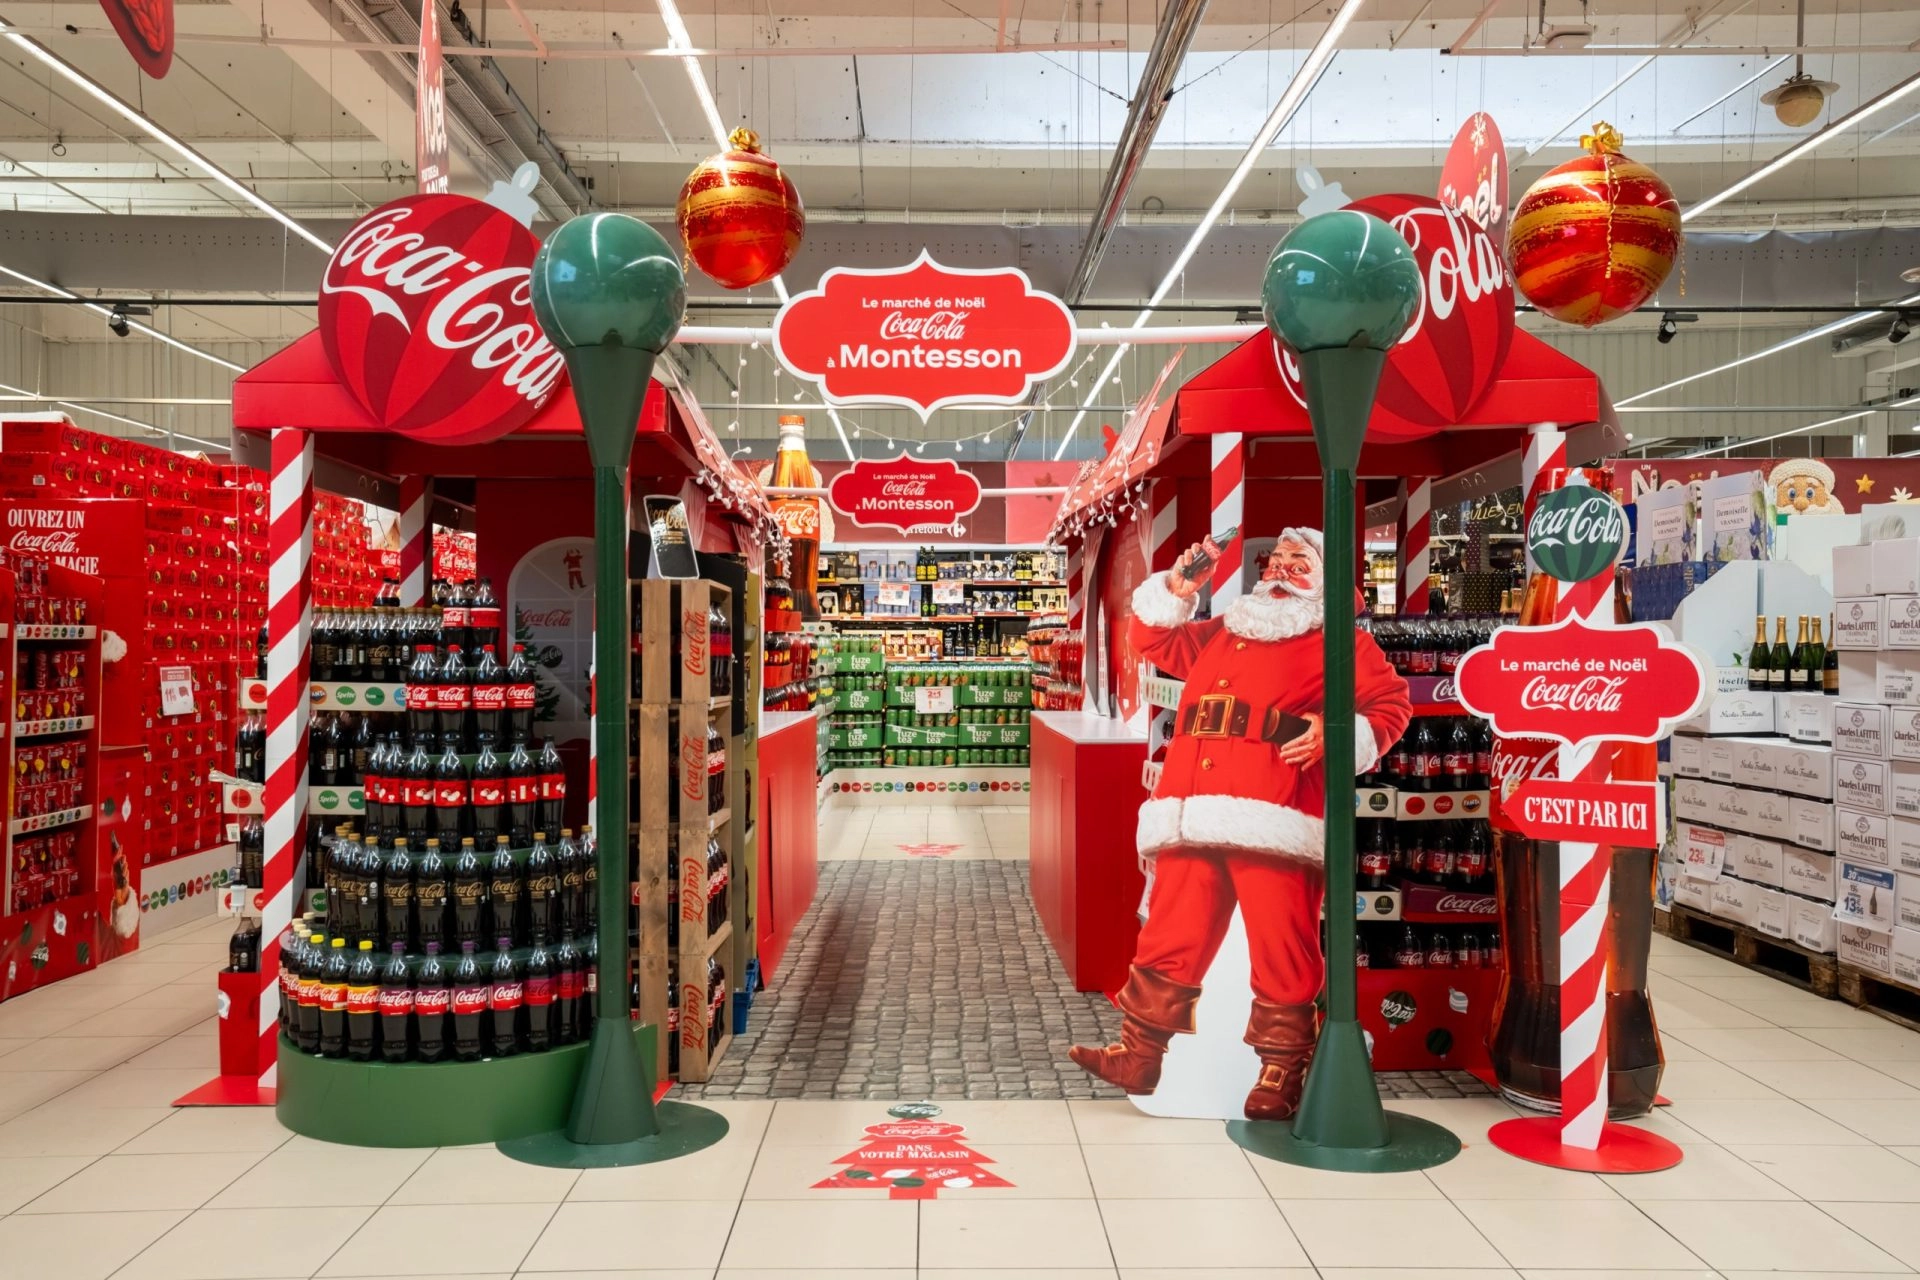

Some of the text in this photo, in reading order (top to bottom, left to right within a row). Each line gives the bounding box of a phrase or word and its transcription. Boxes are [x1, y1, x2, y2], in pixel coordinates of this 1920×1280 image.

[322, 207, 566, 402] Coca-Cola
[862, 296, 986, 309] Le marché de Noël
[880, 311, 970, 341] Coca-Cola
[826, 344, 1022, 369] à Montesson
[882, 480, 928, 496] Coca-Cola
[862, 497, 955, 510] Montesson
[8, 508, 85, 529] OUVREZ UN
[1527, 497, 1622, 551] Coca-Cola
[1837, 621, 1877, 631] Charles LAFITTE
[1890, 619, 1910, 629] Charles
[683, 609, 707, 676] Coca-Cola
[1500, 657, 1648, 672] Le marché de Noël
[1520, 675, 1629, 712] Coca-Cola
[1837, 726, 1880, 740] Charles LAFITTE
[1894, 730, 1915, 741] Charles
[682, 735, 705, 801] Coca-Cola
[1838, 778, 1858, 790] Charles
[1857, 783, 1882, 794] LAFITTE
[1524, 795, 1648, 831] C'EST PAR ICI
[1840, 831, 1887, 849] Charles LAFITTE
[682, 857, 705, 925] Coca-Cola
[1841, 934, 1888, 957] Charles LAFITTE
[682, 983, 705, 1050] Coca-Cola
[859, 1151, 970, 1159] VOTRE MAGASIN
[896, 1144, 933, 1152] DANS
